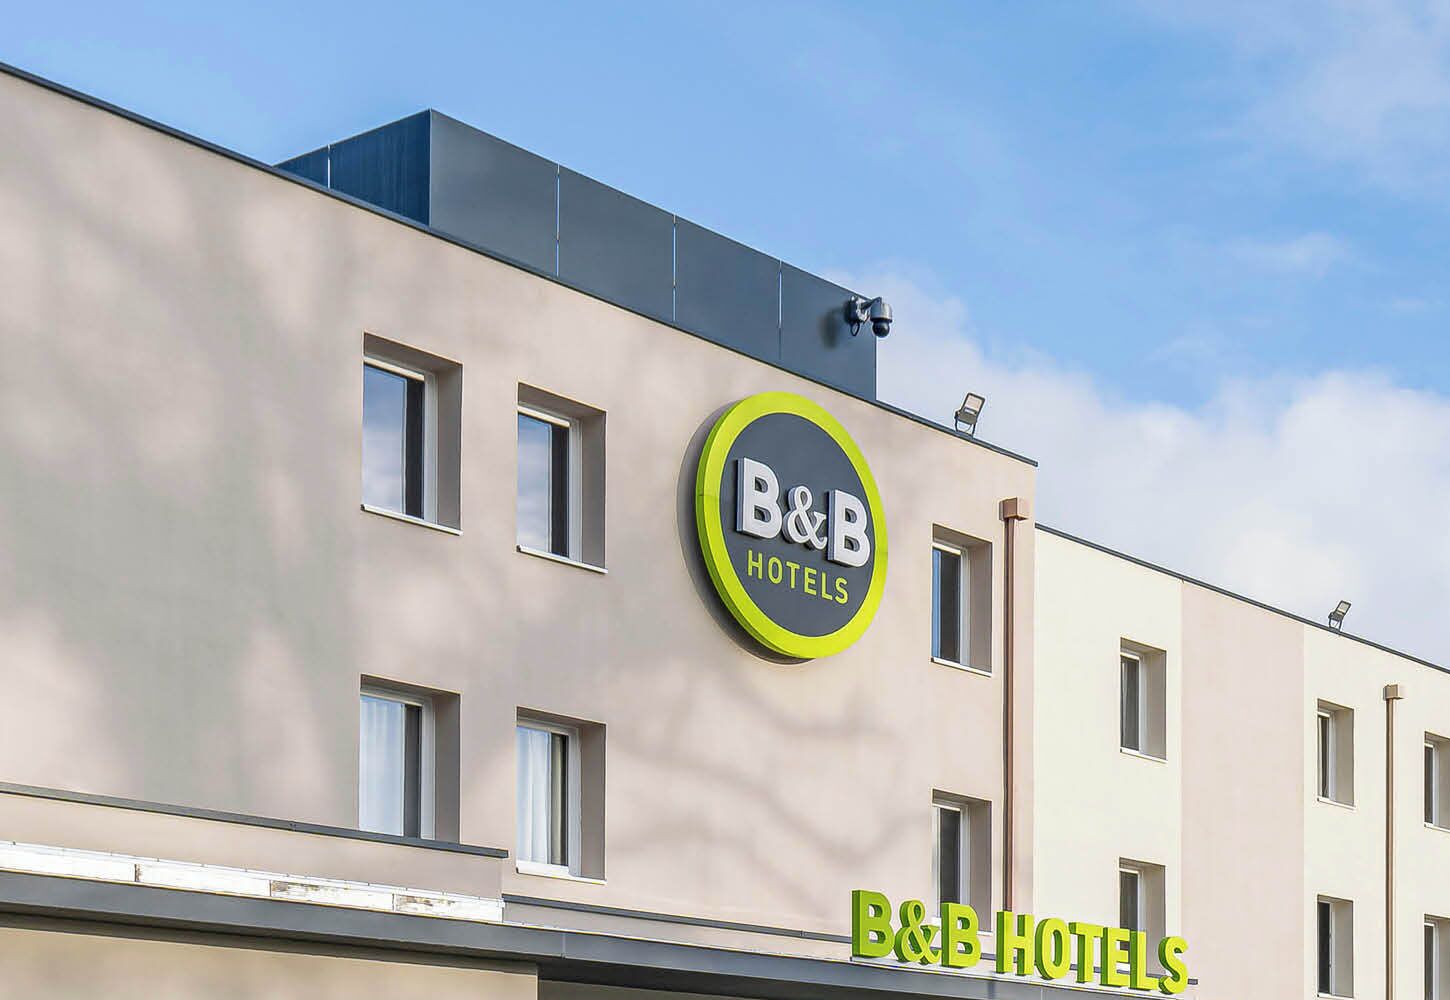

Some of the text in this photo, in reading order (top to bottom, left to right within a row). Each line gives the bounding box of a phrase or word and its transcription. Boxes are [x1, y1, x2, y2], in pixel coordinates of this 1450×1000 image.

[738, 457, 870, 567] B&B
[747, 549, 849, 604] HOTELS
[852, 890, 1189, 995] B&B HOTELS
